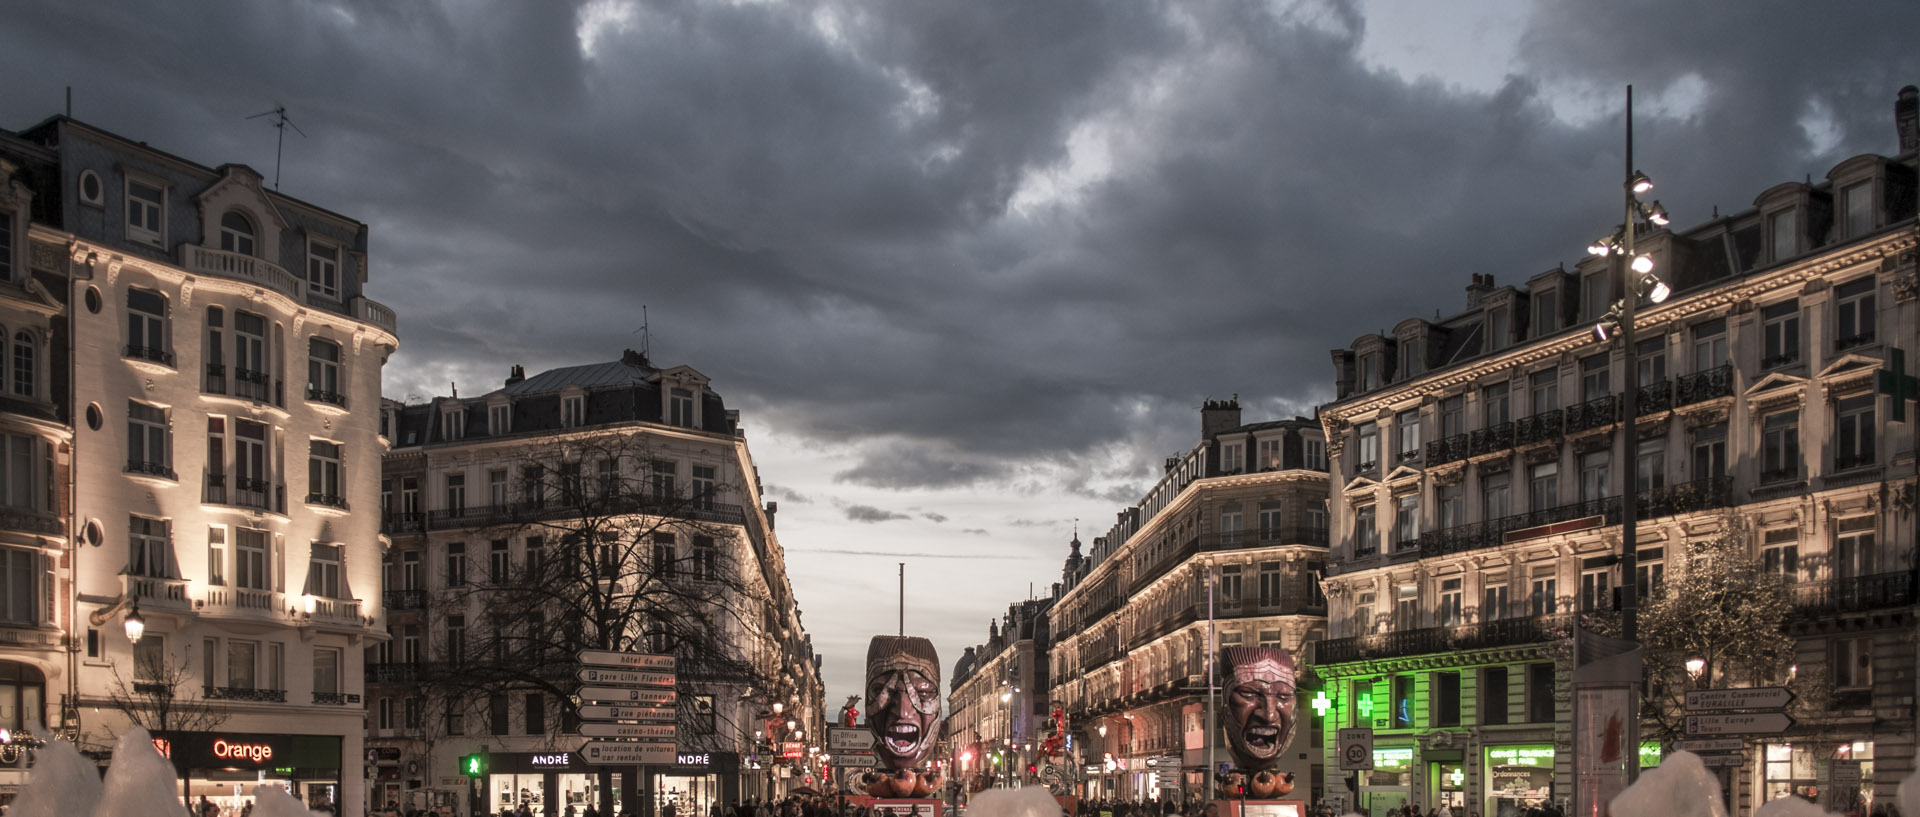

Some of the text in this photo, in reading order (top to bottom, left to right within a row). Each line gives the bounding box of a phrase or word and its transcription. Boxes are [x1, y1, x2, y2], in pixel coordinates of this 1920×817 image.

[657, 658, 674, 666] ville
[642, 674, 674, 683] Flandres
[1732, 690, 1780, 699] Commercial
[1701, 700, 1746, 708] EURALILLE
[637, 710, 674, 718] piétonnes
[618, 727, 674, 735] casino-théâtre
[214, 740, 272, 762] Orange
[1351, 750, 1362, 758] 30
[532, 753, 569, 764] ANDRÉ
[678, 754, 710, 764] NDRÉ
